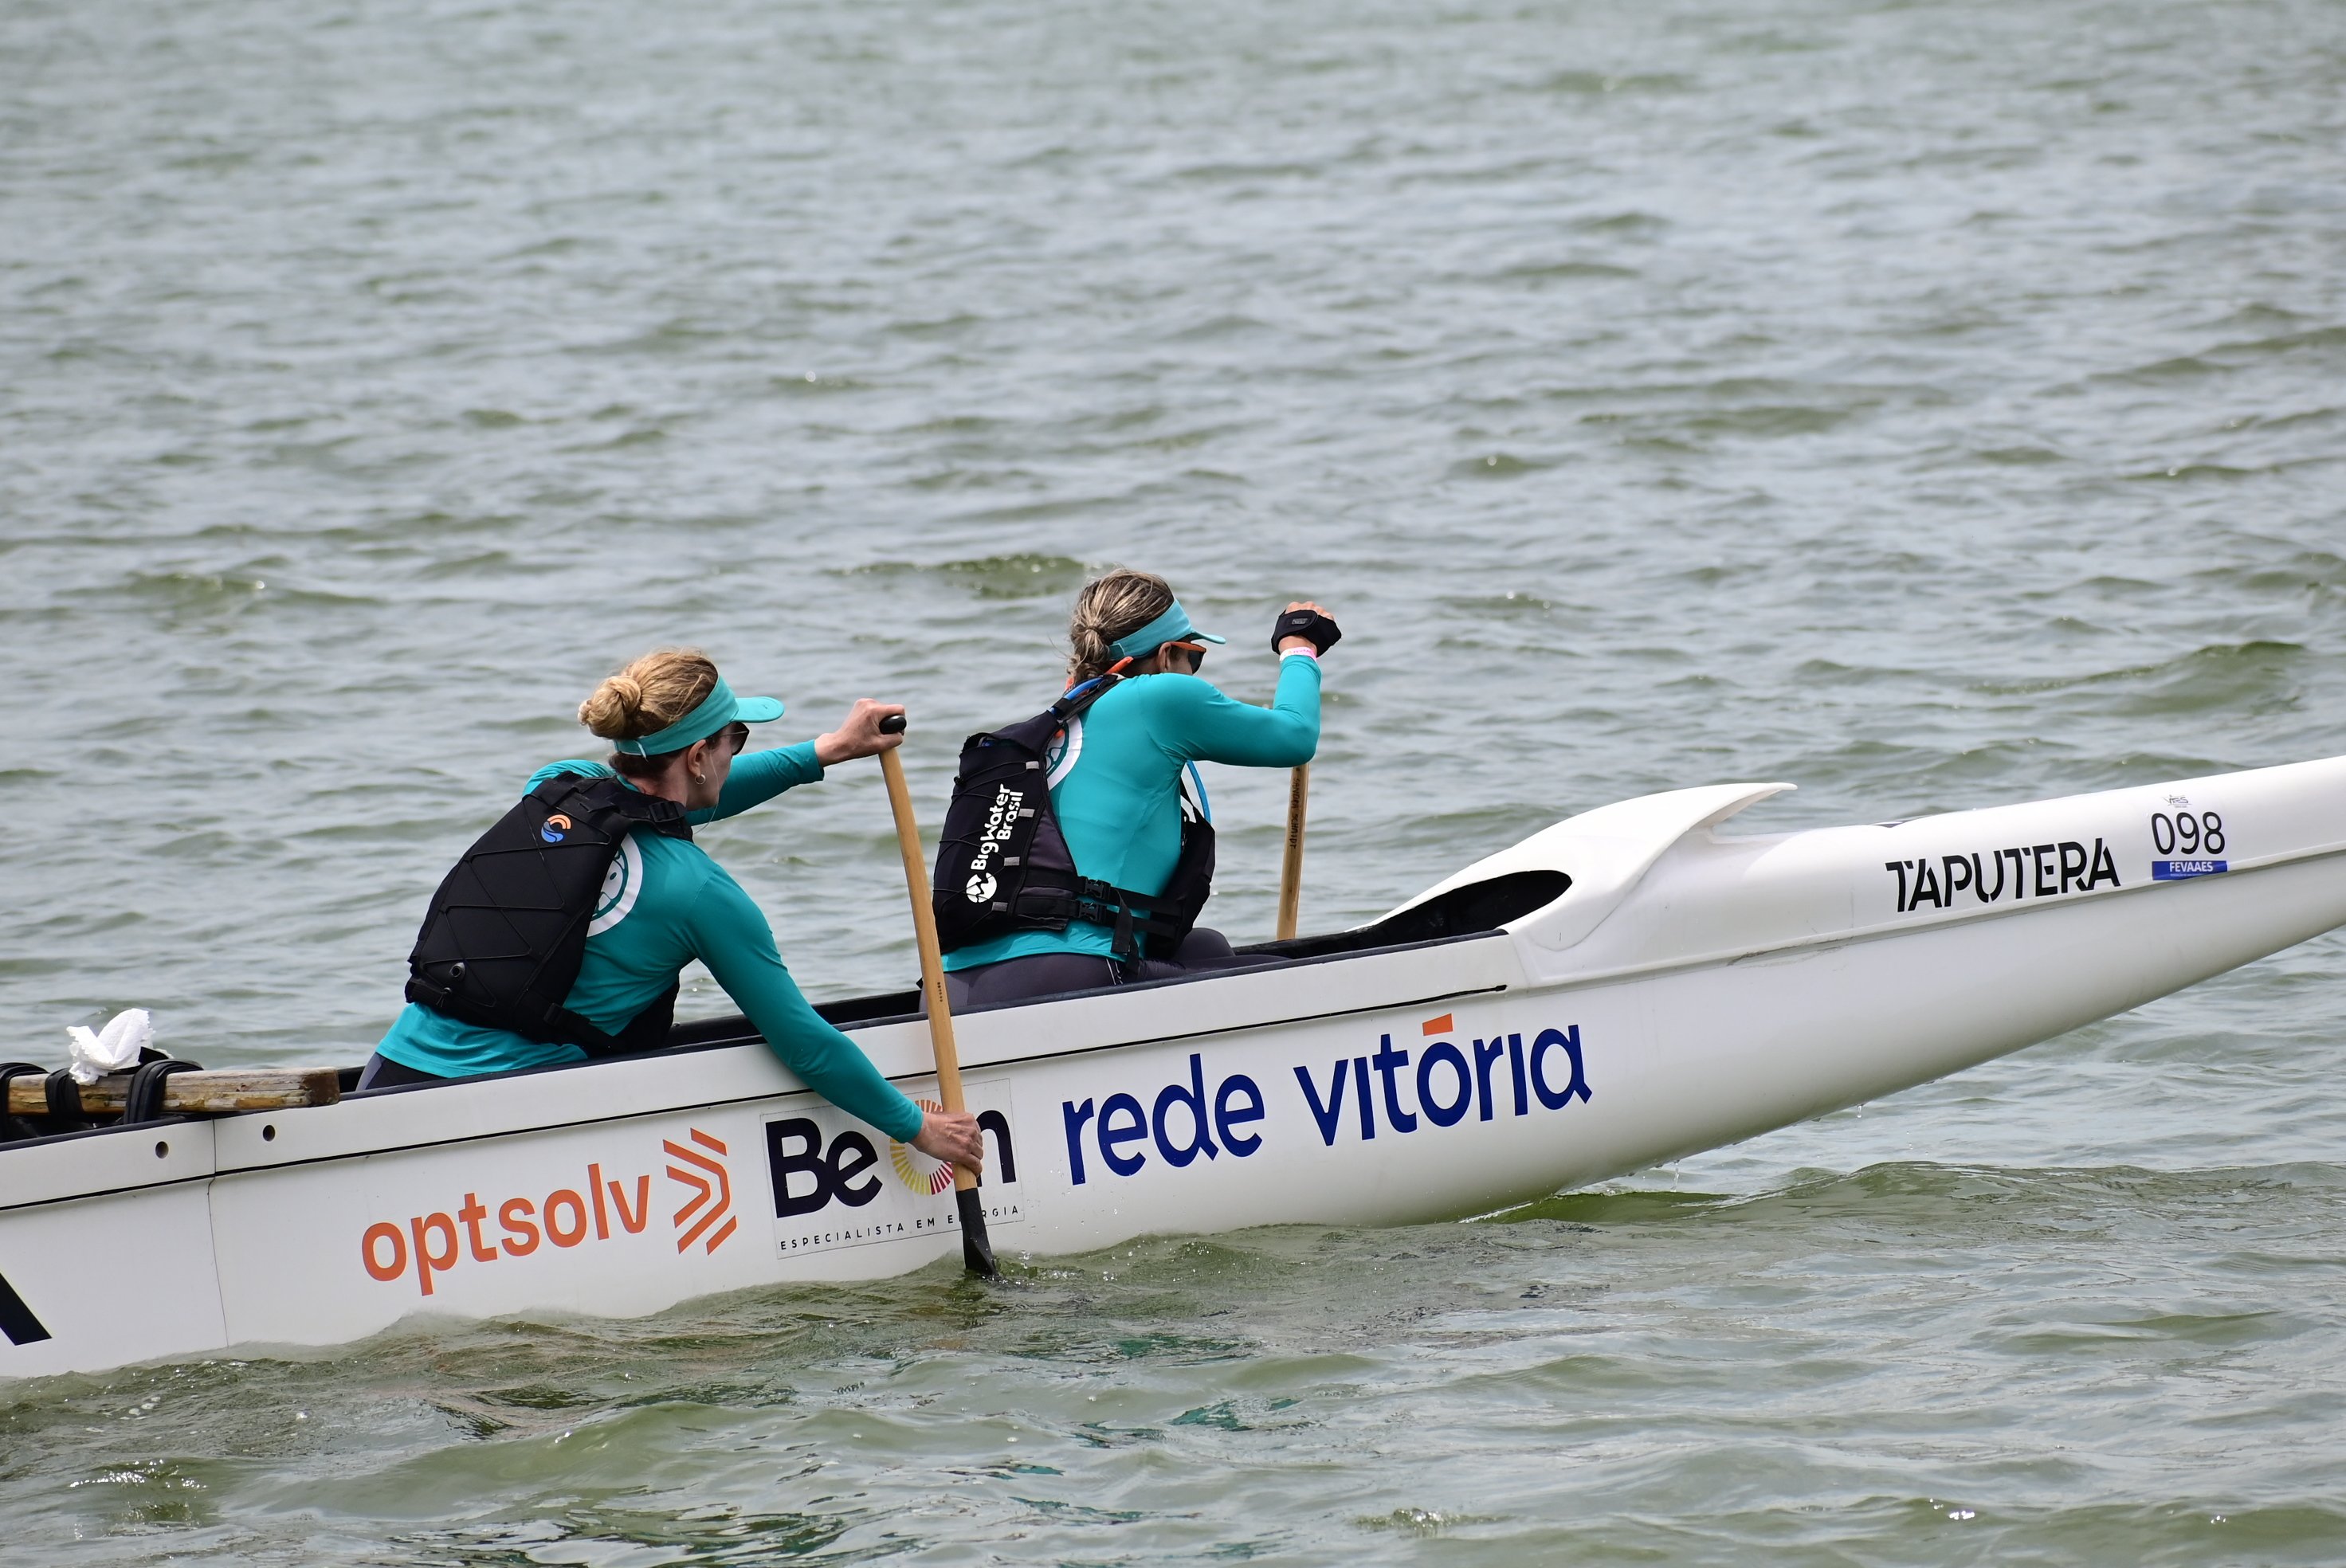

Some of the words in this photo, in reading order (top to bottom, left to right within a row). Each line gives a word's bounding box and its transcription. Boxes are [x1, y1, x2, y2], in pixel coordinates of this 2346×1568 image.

[996, 791, 1024, 840] Brasil
[2151, 811, 2225, 855] 098
[1885, 838, 2121, 912] TAPUTERA
[2169, 861, 2213, 872] FEVAAES
[1062, 1053, 1265, 1186] rede
[1293, 1013, 1592, 1147] vitória
[362, 1163, 649, 1296] optsolv
[780, 1222, 904, 1250] ESPECIALISTA
[916, 1217, 935, 1229] EM
[947, 1205, 1019, 1225] ERGIA
